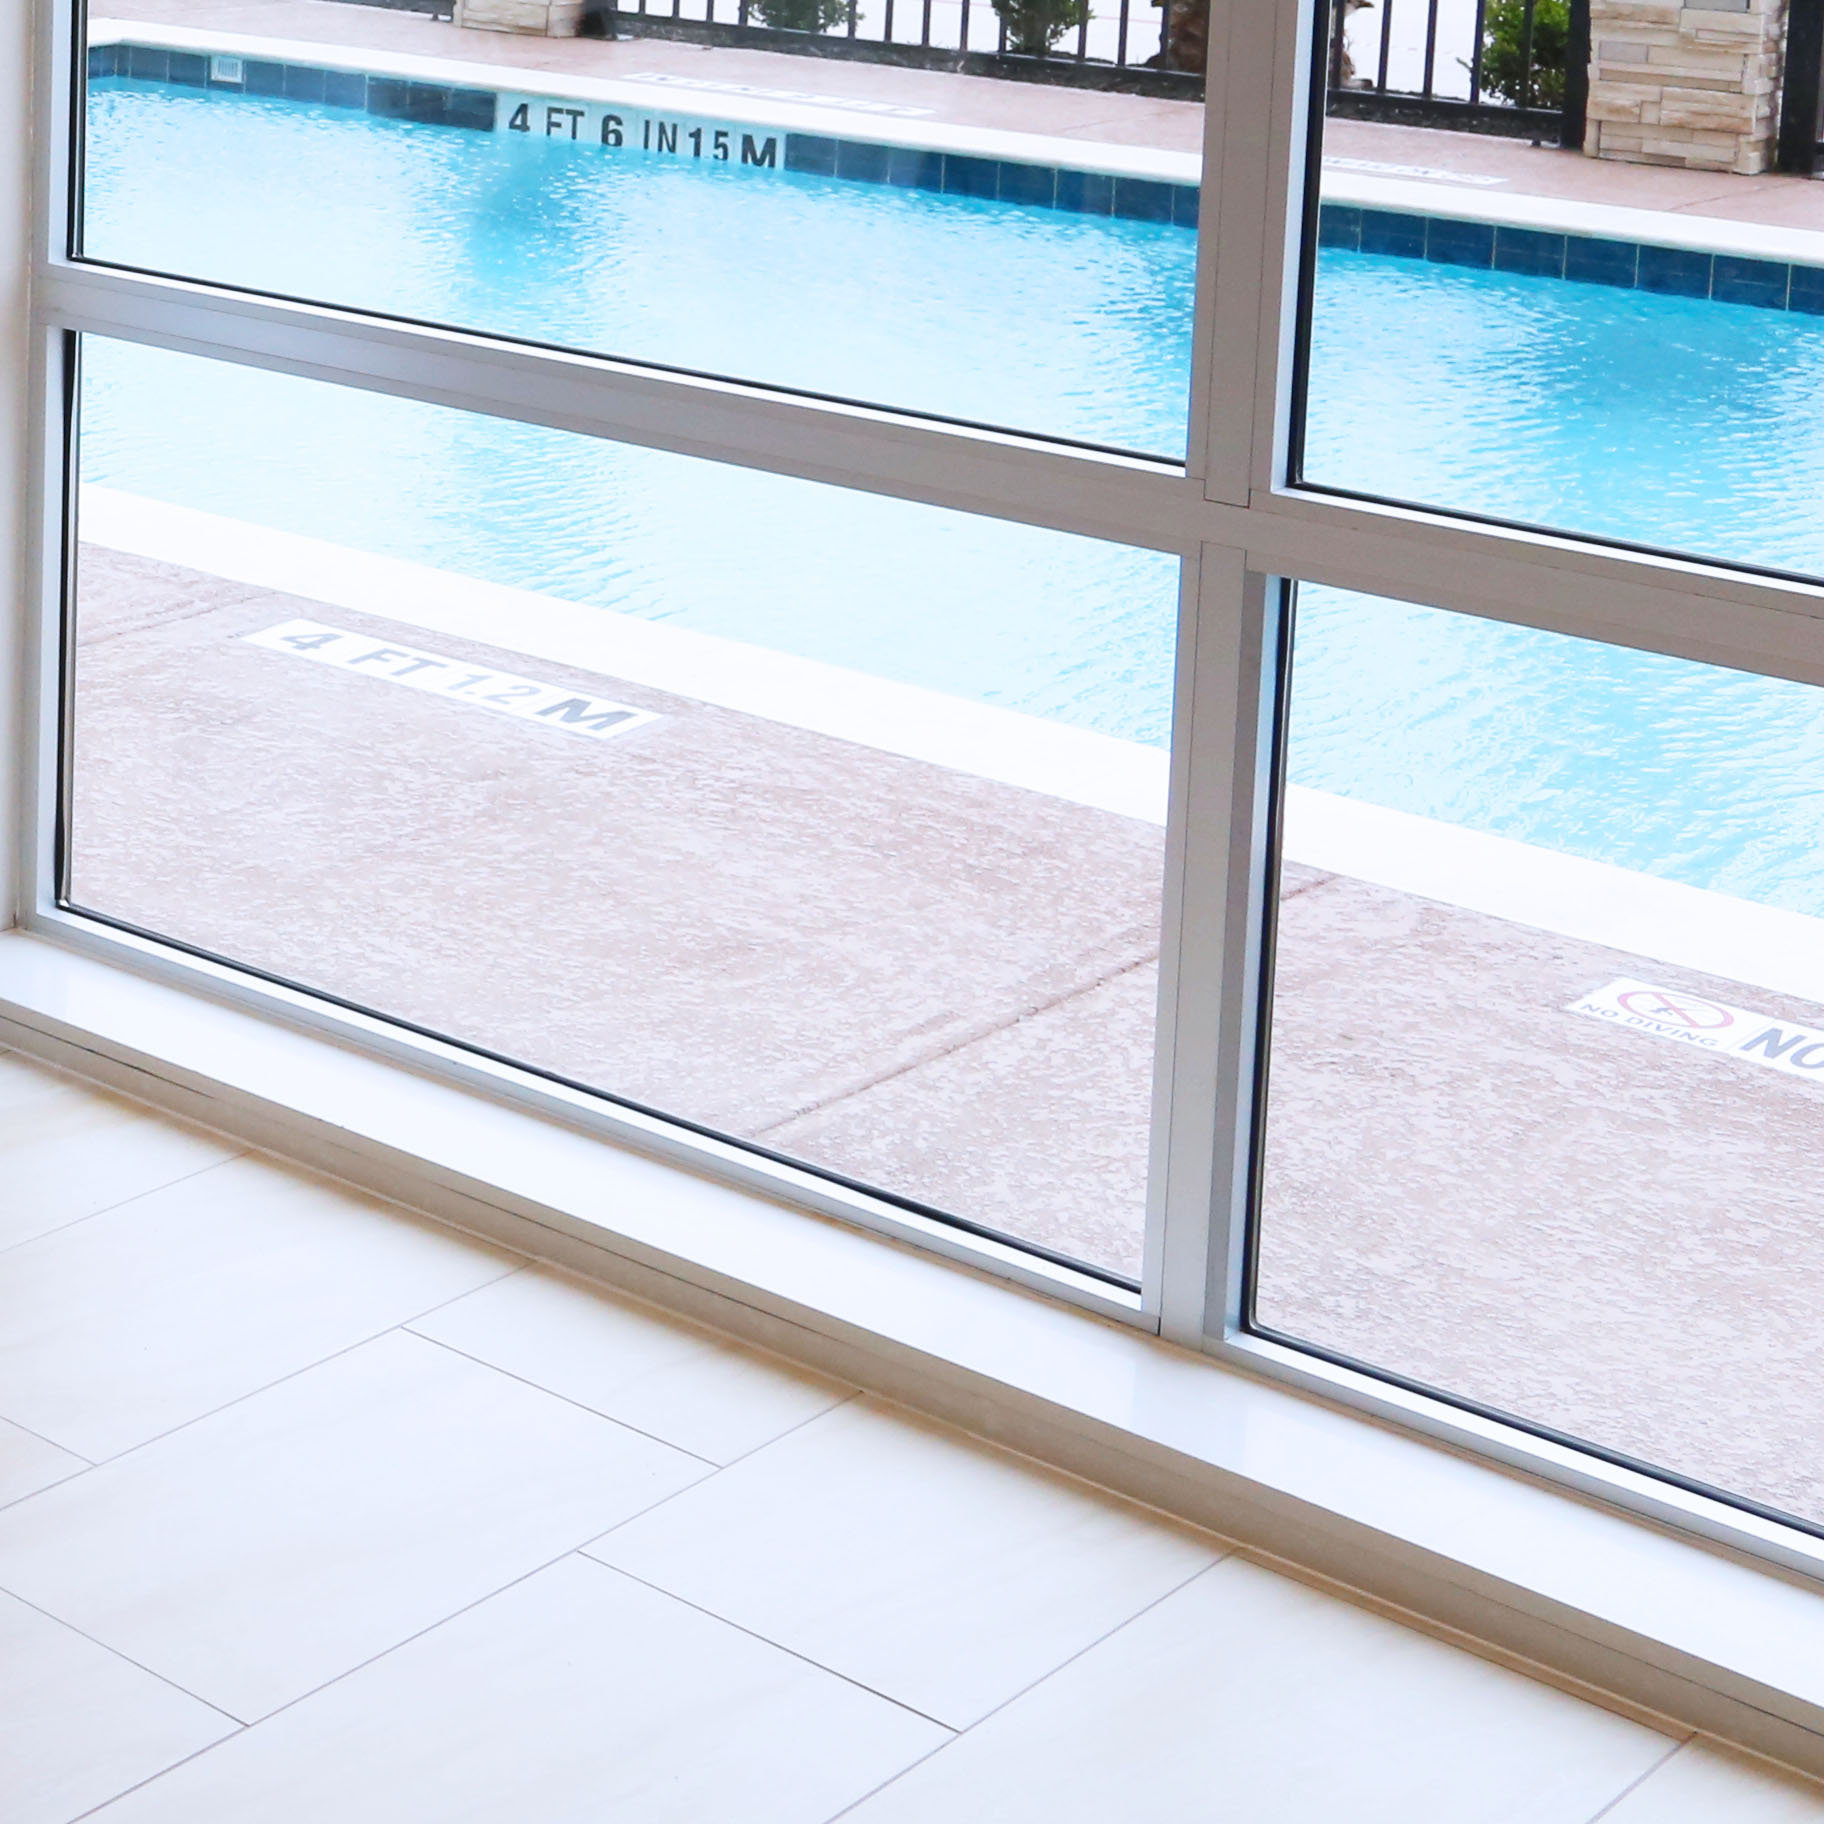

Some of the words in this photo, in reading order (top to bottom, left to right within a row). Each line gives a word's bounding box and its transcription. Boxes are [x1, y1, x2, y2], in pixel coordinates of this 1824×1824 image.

[508, 103, 531, 133] 4
[546, 107, 585, 140] FT
[602, 114, 625, 148] 6
[643, 119, 678, 154] IN
[741, 133, 777, 168] M
[279, 632, 343, 655] 4
[346, 647, 449, 676] FT
[538, 697, 640, 732] M
[1580, 1003, 1619, 1019] NO
[1626, 1016, 1720, 1047] DIVING
